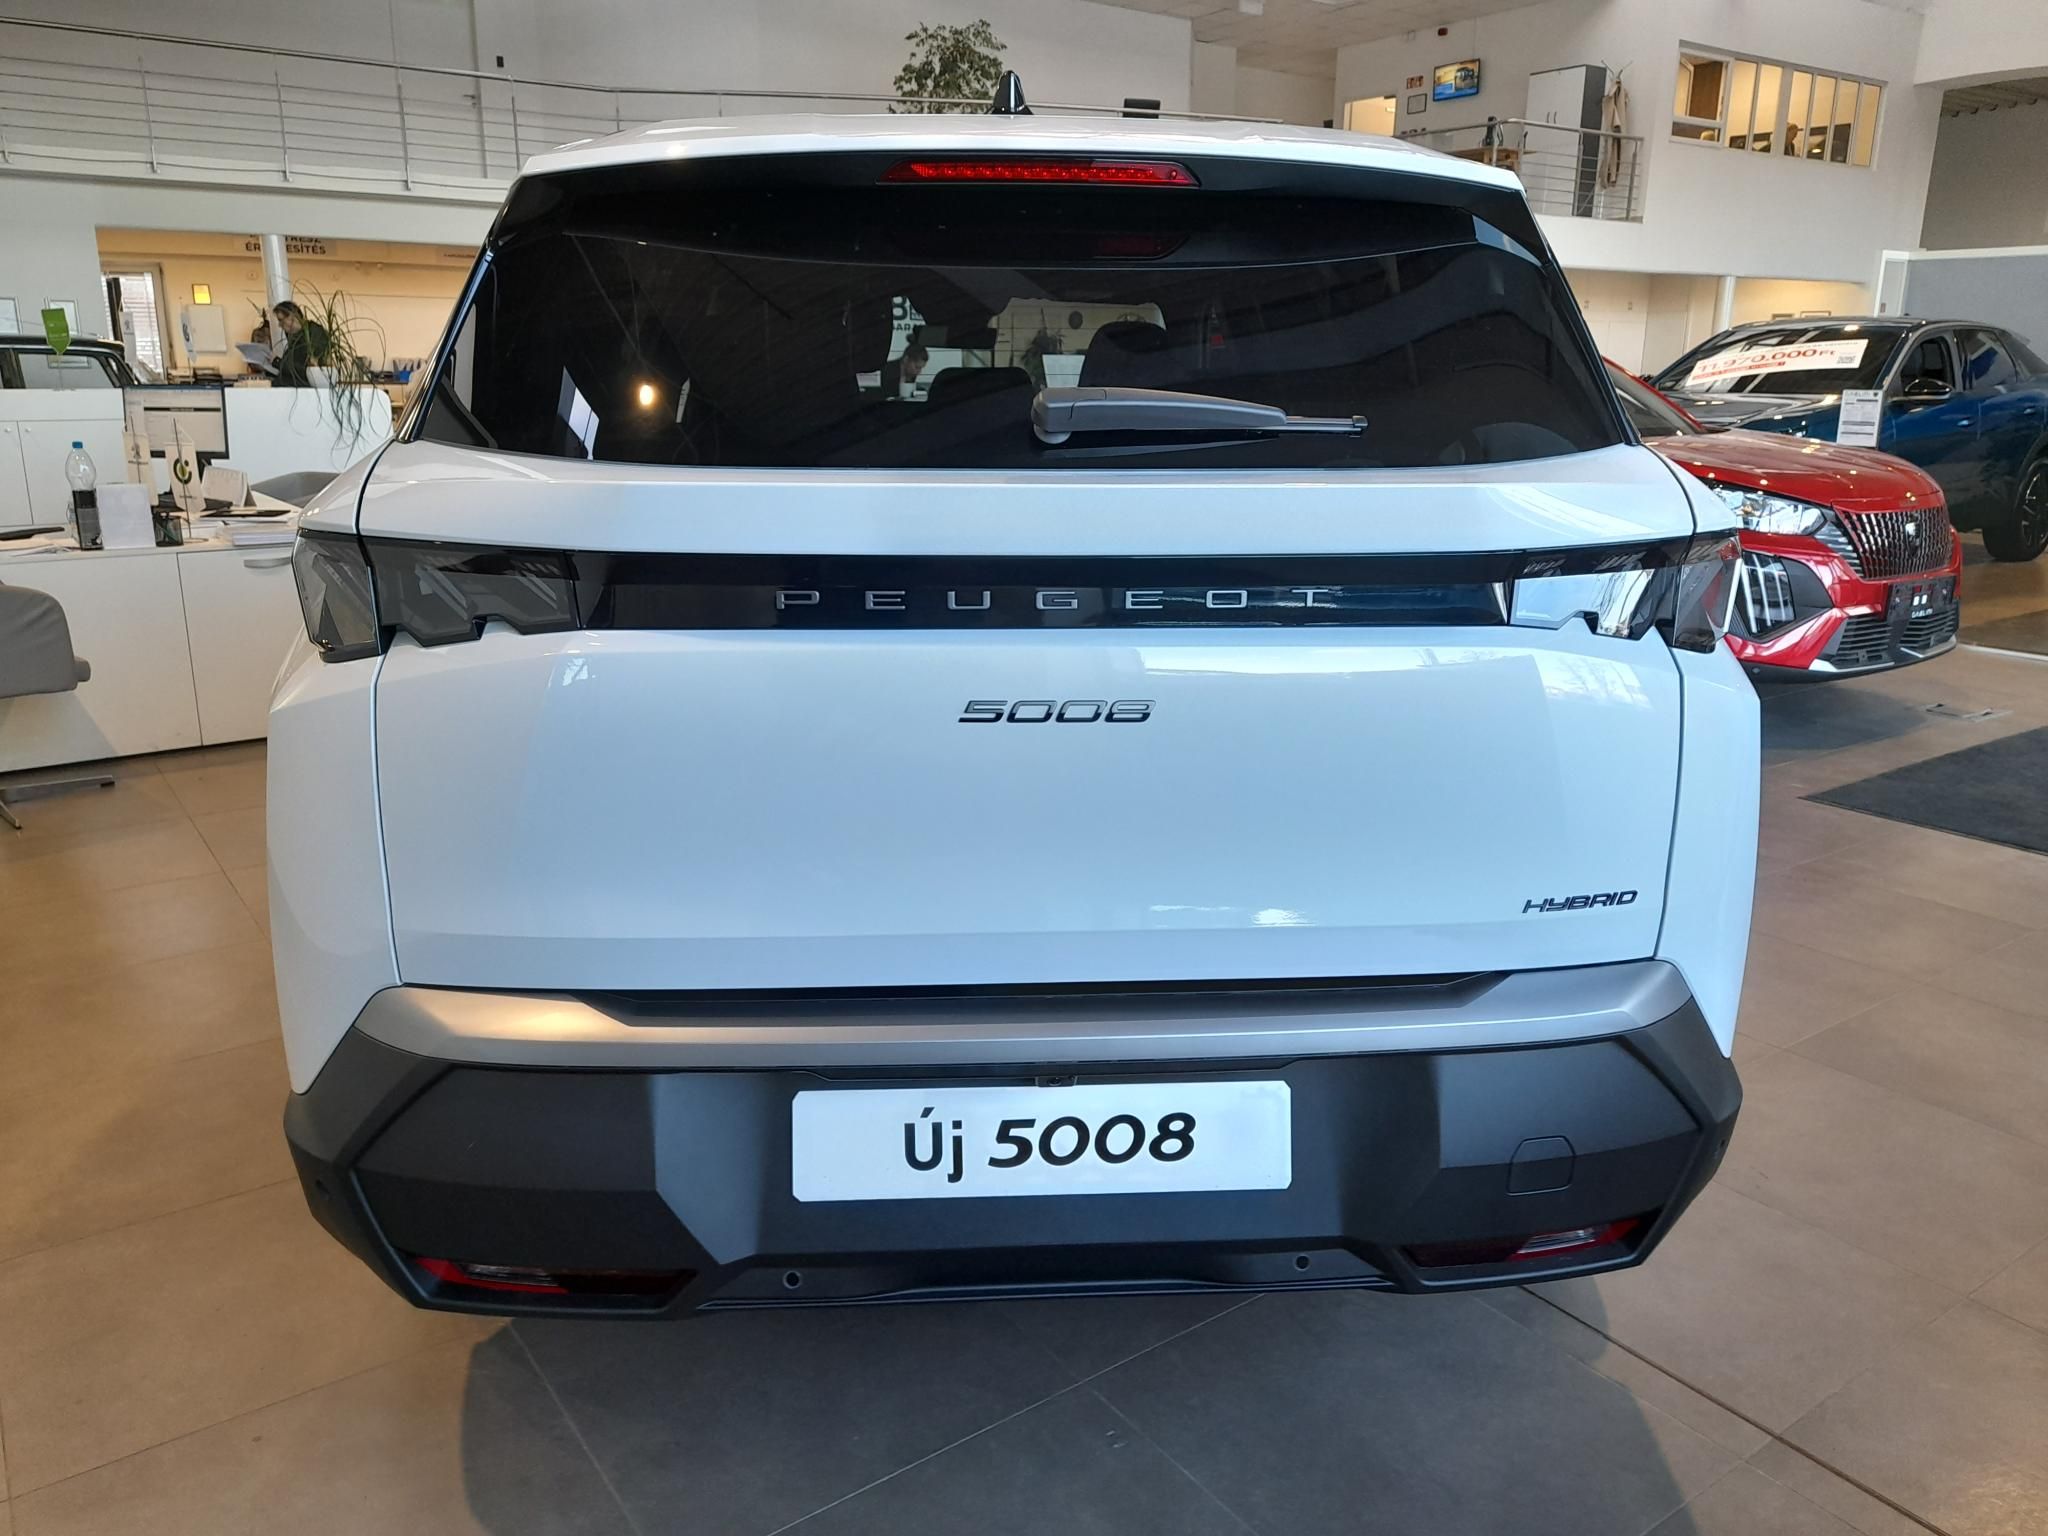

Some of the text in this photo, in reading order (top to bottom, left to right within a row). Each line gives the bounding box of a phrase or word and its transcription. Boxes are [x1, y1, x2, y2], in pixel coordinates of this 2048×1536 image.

[245, 241, 327, 255] ÉRESÍTÉS
[776, 588, 1329, 610] PEUGEOT
[958, 700, 1157, 723] 5008
[1521, 889, 1639, 914] HYBRID
[904, 1106, 1196, 1184] Új 5008
